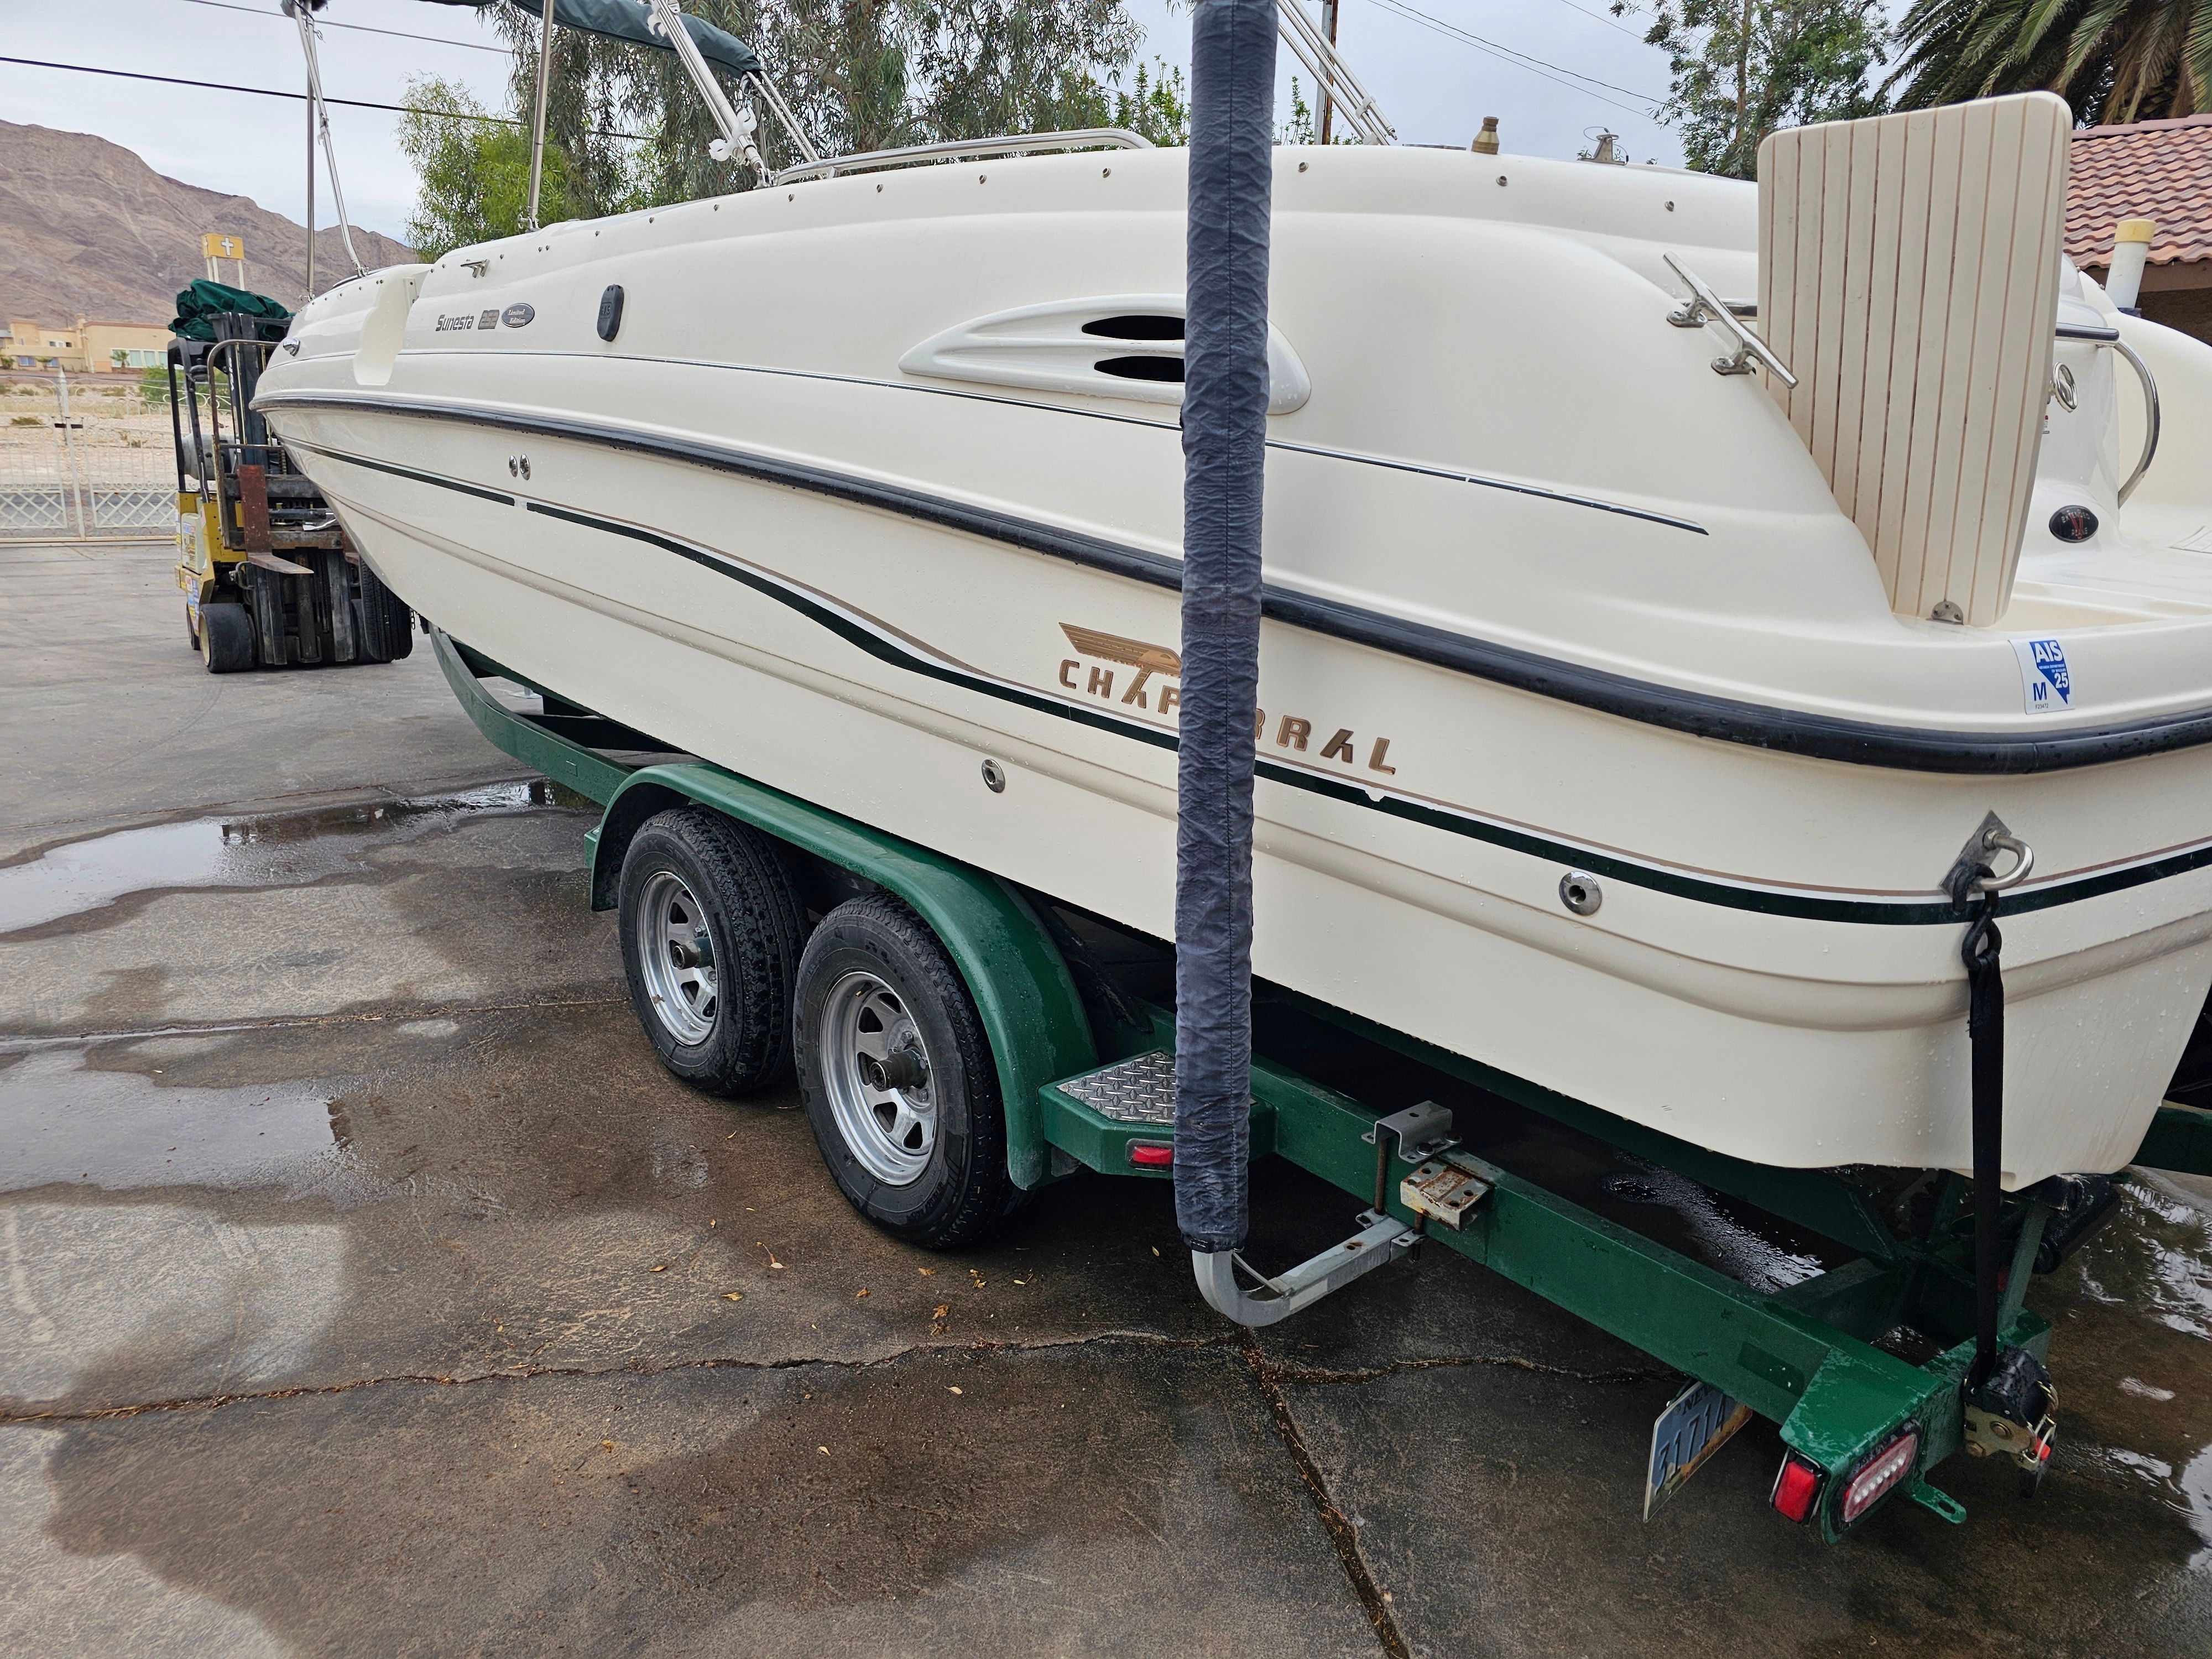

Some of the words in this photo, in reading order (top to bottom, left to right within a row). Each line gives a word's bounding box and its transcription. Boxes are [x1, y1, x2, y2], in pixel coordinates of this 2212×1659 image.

[435, 313, 474, 332] Sunesta
[2034, 641, 2063, 663] AIS
[2054, 672, 2069, 688] 25
[2033, 681, 2047, 701] M
[1059, 659, 1395, 775] CHAPRAL
